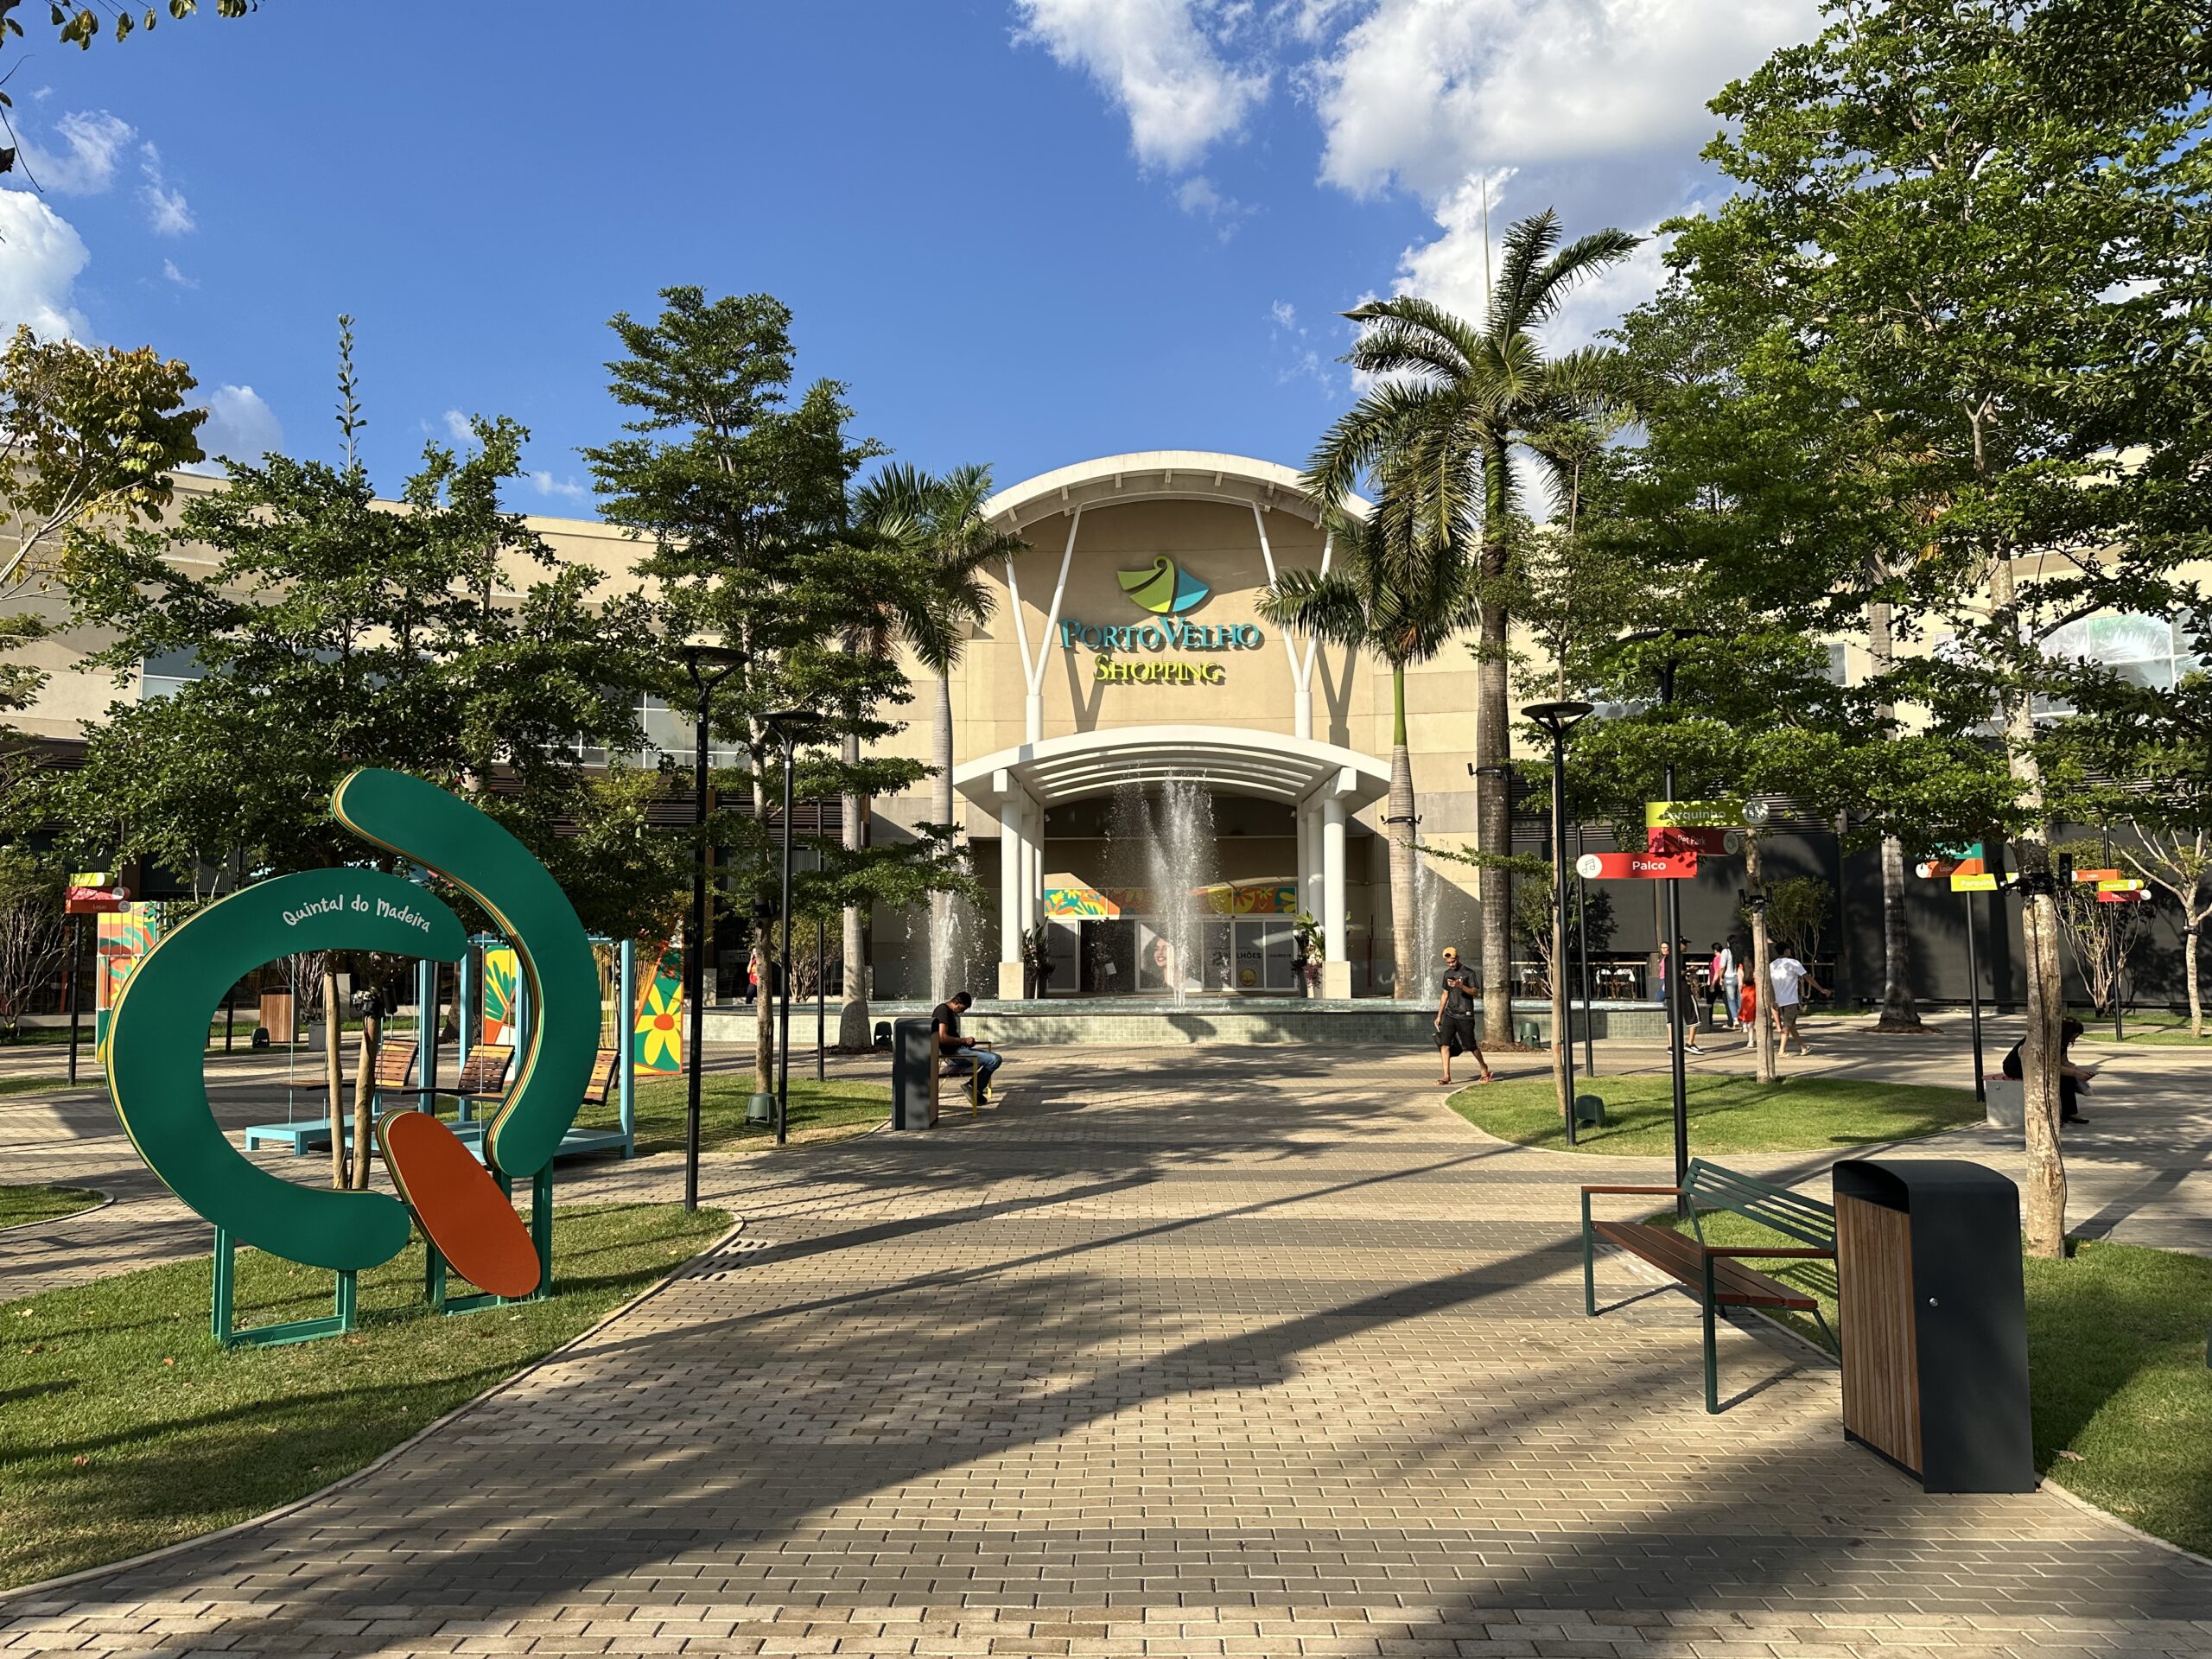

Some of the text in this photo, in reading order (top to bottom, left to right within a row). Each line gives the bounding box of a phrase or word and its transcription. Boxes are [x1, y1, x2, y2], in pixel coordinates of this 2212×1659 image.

[1094, 653, 1219, 681] SHOPPING
[1677, 835, 1706, 845] Pet Park
[1632, 861, 1667, 870] Palco
[283, 894, 431, 932] Quintal do Madeira
